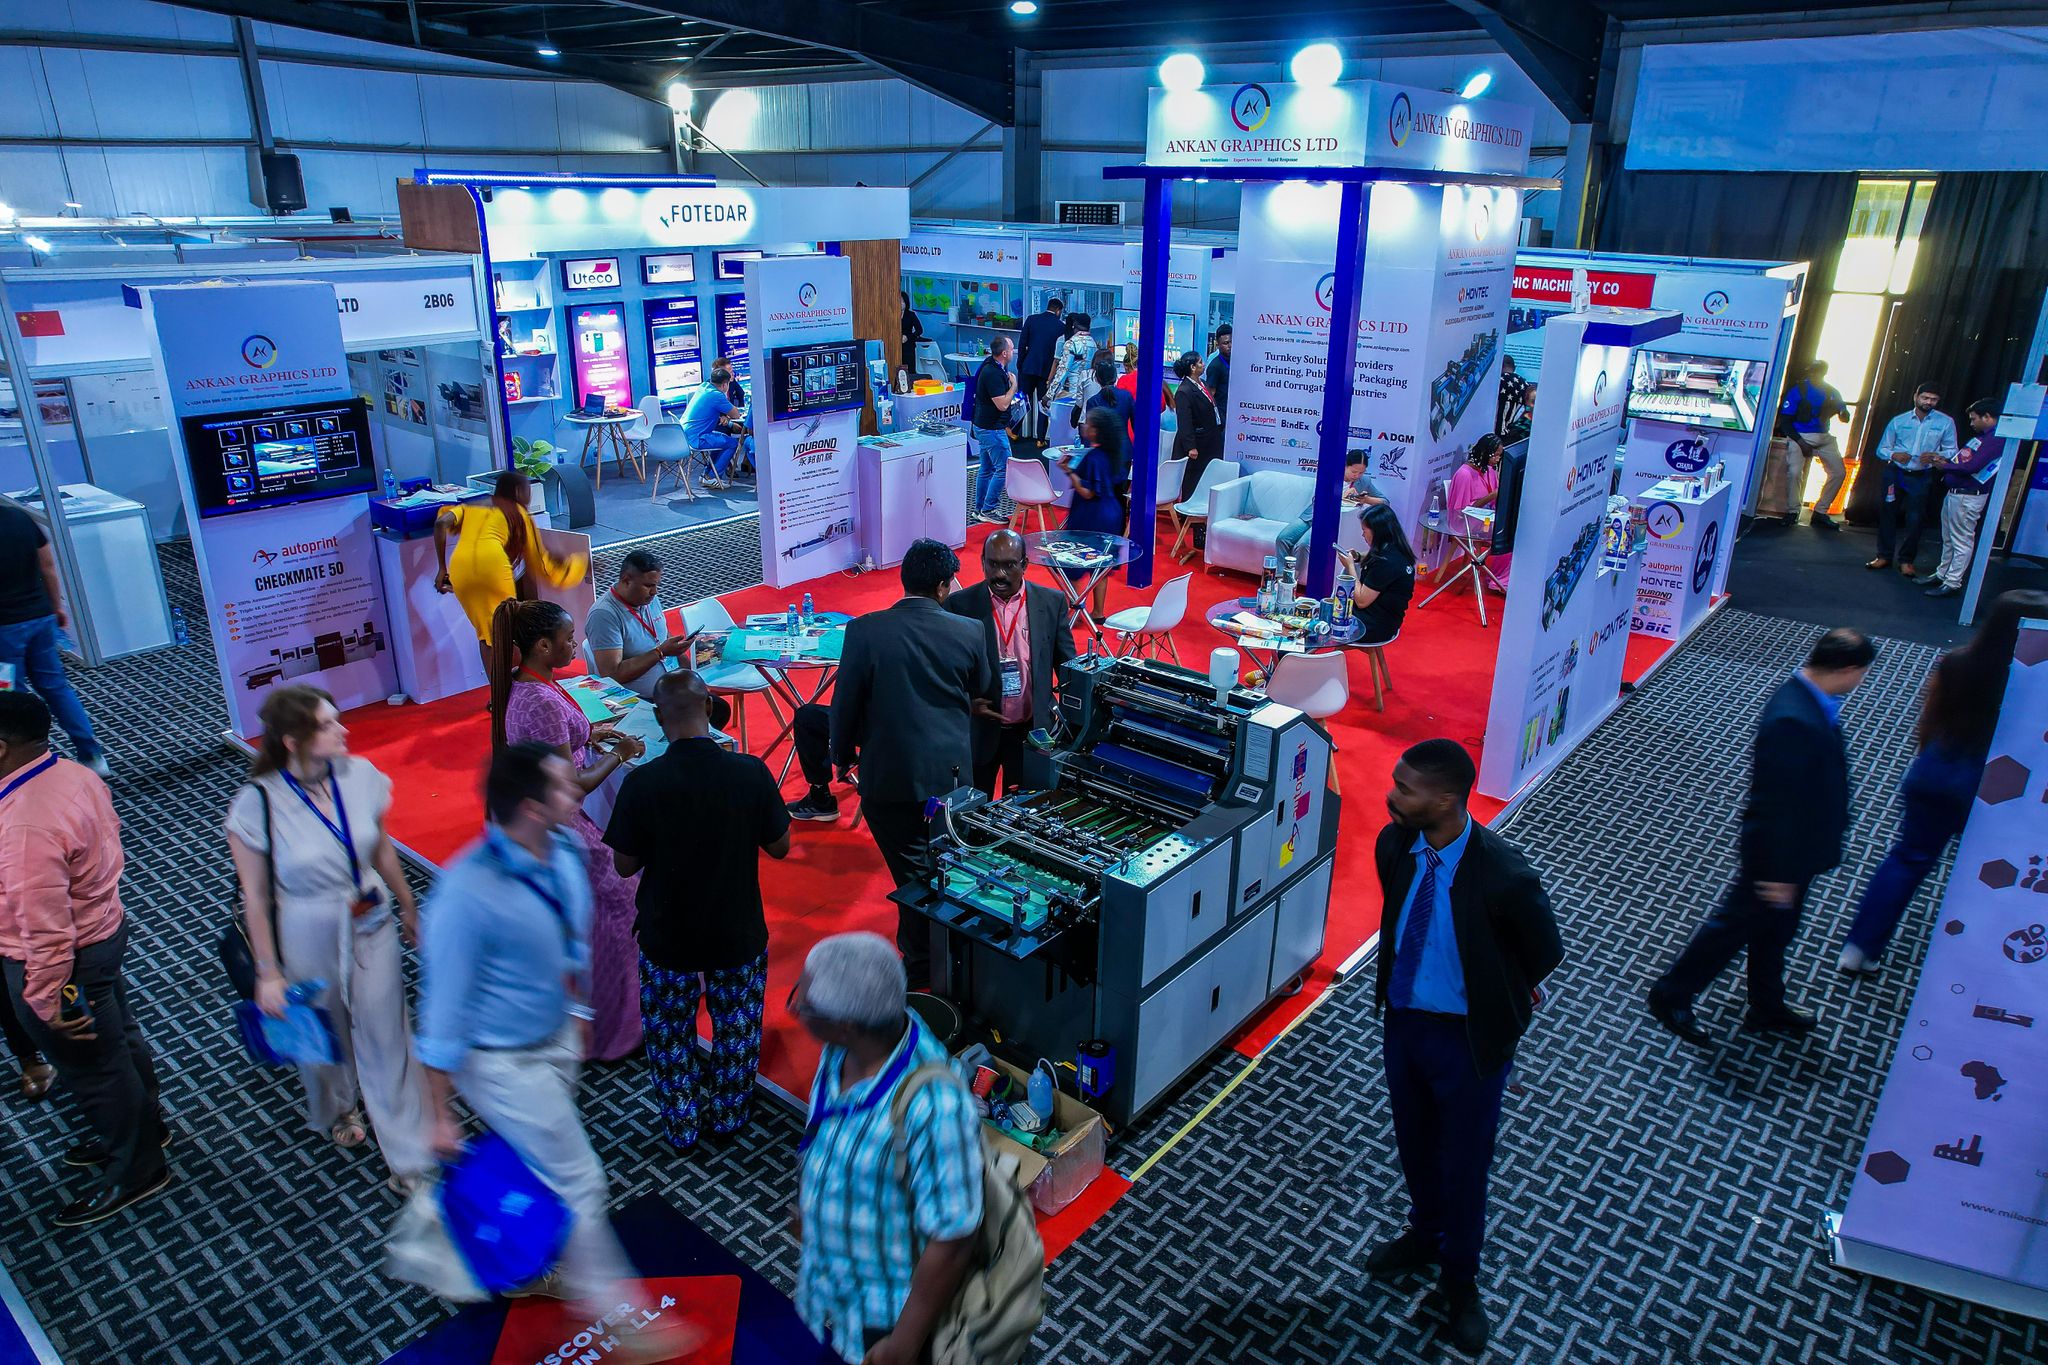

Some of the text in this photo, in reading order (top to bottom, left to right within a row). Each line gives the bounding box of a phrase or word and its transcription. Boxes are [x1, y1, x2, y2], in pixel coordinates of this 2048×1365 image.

[1413, 111, 1523, 147] ANKAN GRAPHICS LTD
[1166, 137, 1338, 153] ANKAN GRAPHICS LTD
[671, 204, 747, 223] FOTEDAR
[901, 245, 942, 256] MOULD CO., LTD
[979, 250, 994, 260] 2A06
[573, 272, 613, 285] Uteco
[1532, 278, 1601, 295] MACHIRY
[1602, 282, 1620, 295] CO
[1465, 285, 1490, 300] HONTEC
[335, 297, 360, 313] LTD
[423, 293, 455, 309] 2B06
[769, 307, 847, 321] ANKAN GRAPHICS LTD
[1257, 313, 1303, 326] ANKAN
[1380, 321, 1408, 334] LTD
[1694, 317, 1746, 328] GRAPHICS
[1748, 320, 1769, 329] LTD
[1264, 351, 1394, 372] Turnkey Solut roviders
[186, 375, 236, 391] ANKAN
[239, 369, 309, 386] GRAPHICS
[311, 367, 337, 378] LTD
[1250, 364, 1264, 373] for
[1265, 365, 1304, 378] Printing,
[1359, 373, 1408, 389] Packaging
[1265, 379, 1281, 389] and
[1283, 380, 1326, 394] Corrugati
[926, 403, 961, 419] FOTEDA
[1239, 401, 1320, 417] EXCLUSIVE DEALER FOR:
[1250, 415, 1277, 424] autoprint
[1280, 419, 1310, 431] BindEx
[1571, 403, 1620, 432] ANKAN GRAPHICS LTD
[792, 437, 837, 457] YOUBOND
[1246, 434, 1275, 444] HONTEC
[1576, 454, 1608, 485] HONTEC
[1635, 472, 1668, 480] AUTOMAT
[281, 535, 338, 558] autoprint
[1649, 541, 1681, 551] GRAPHICS
[1648, 561, 1683, 573] autoprint
[254, 561, 345, 592] CHECKMATE 50
[1641, 576, 1684, 590] HONTEC
[1599, 608, 1630, 647] HONTEC
[600, 1309, 661, 1353] HLL
[660, 1294, 676, 1310] 4
[535, 1302, 636, 1365] SCOVER
